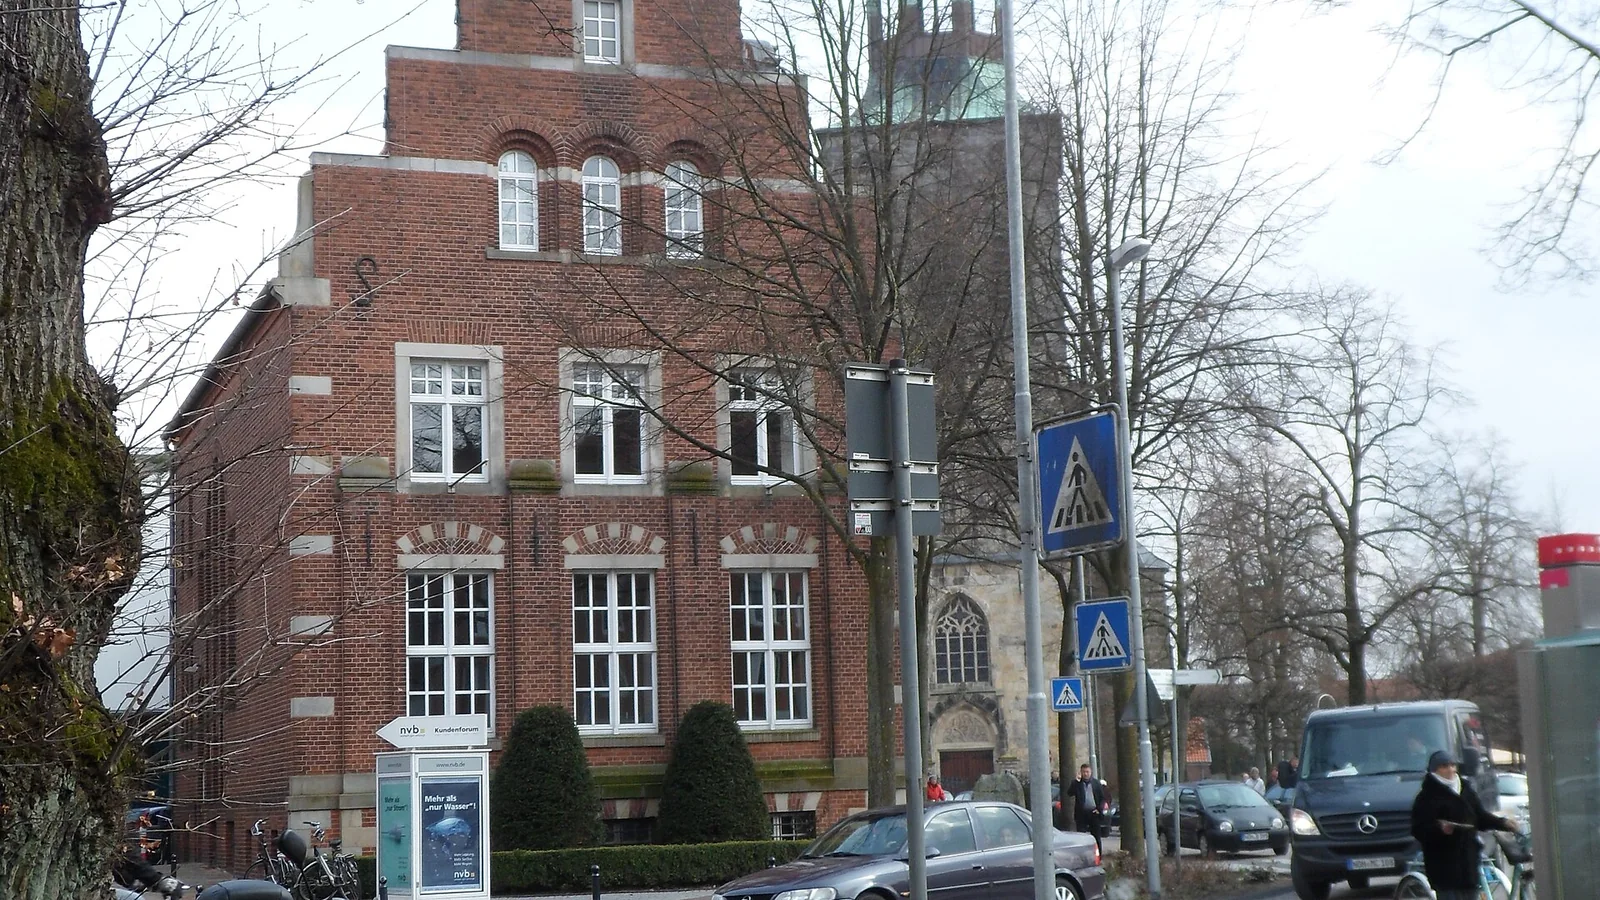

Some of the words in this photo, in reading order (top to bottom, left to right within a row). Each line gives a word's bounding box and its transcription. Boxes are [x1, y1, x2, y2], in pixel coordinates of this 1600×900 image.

[400, 724, 420, 734] nvb
[434, 726, 479, 734] Kundenforum
[424, 795, 444, 803] Mehr
[446, 794, 457, 802] als
[454, 869, 470, 878] nvb
